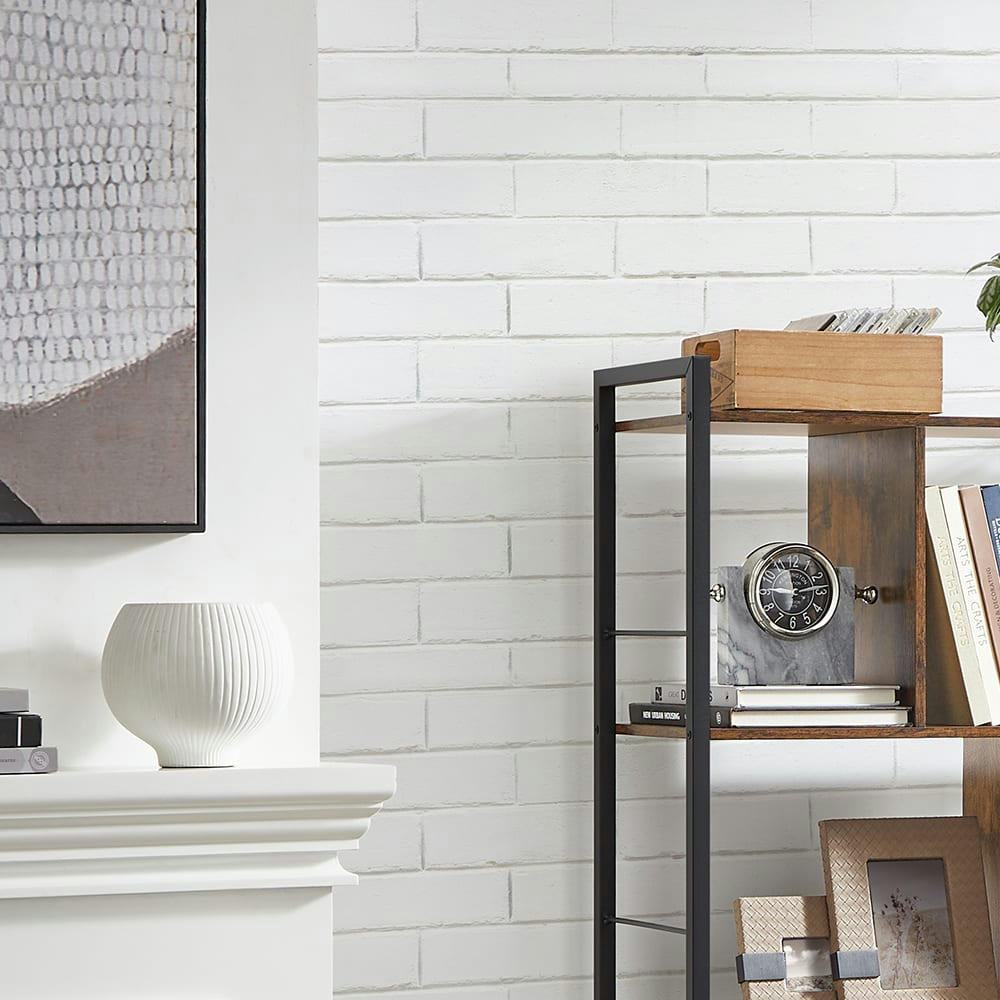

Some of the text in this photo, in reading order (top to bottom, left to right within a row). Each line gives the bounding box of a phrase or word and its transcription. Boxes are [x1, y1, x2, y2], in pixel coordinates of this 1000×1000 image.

[773, 559, 786, 572] 11
[787, 554, 799, 568] 12
[803, 560, 811, 571] 1
[763, 570, 776, 584] 10
[811, 571, 823, 582] 2
[815, 587, 827, 596] 3
[956, 536, 988, 647] ARTS THE CRAFTS
[984, 566, 999, 609] DECORATING
[763, 602, 775, 612] 8
[812, 602, 823, 613] 4
[774, 612, 785, 624] 7
[789, 616, 796, 629] 6
[802, 611, 811, 625] 5
